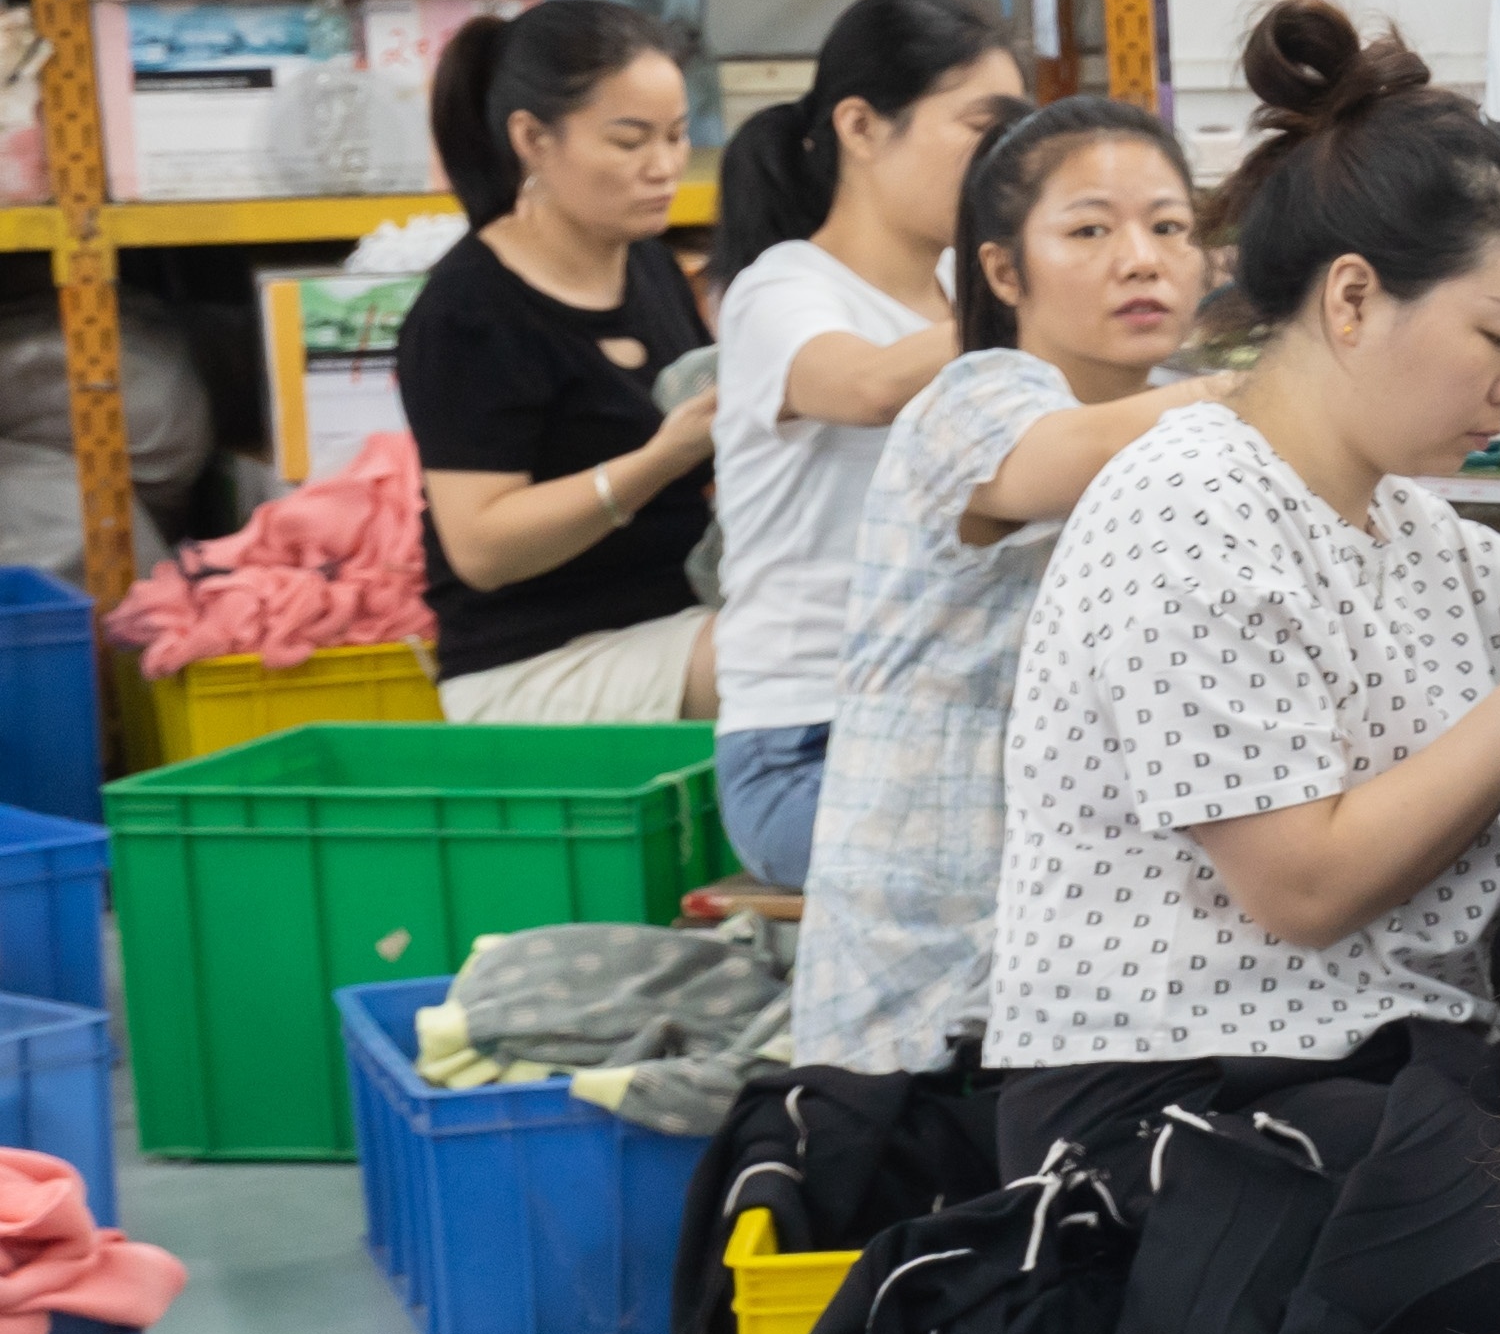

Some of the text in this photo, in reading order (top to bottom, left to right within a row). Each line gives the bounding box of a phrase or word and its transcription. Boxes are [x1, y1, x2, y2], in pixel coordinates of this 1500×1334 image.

[1165, 601, 1180, 614] D
[1339, 601, 1353, 615] D
[1223, 650, 1236, 663] D
[1367, 673, 1382, 687] D
[1183, 703, 1199, 716] D
[1213, 724, 1230, 738] D
[1166, 732, 1180, 745] D
[1244, 745, 1259, 759] D
[1274, 766, 1288, 779] D
[1225, 774, 1241, 788] D
[1176, 783, 1191, 797] D
[1256, 796, 1271, 809] D
[1206, 804, 1222, 817] D
[1191, 956, 1206, 970] D
[1240, 956, 1256, 970] D
[1288, 957, 1302, 970] D
[1168, 981, 1183, 995] D
[1215, 980, 1229, 994] D
[1262, 978, 1276, 992] D
[1172, 1027, 1187, 1042] D
